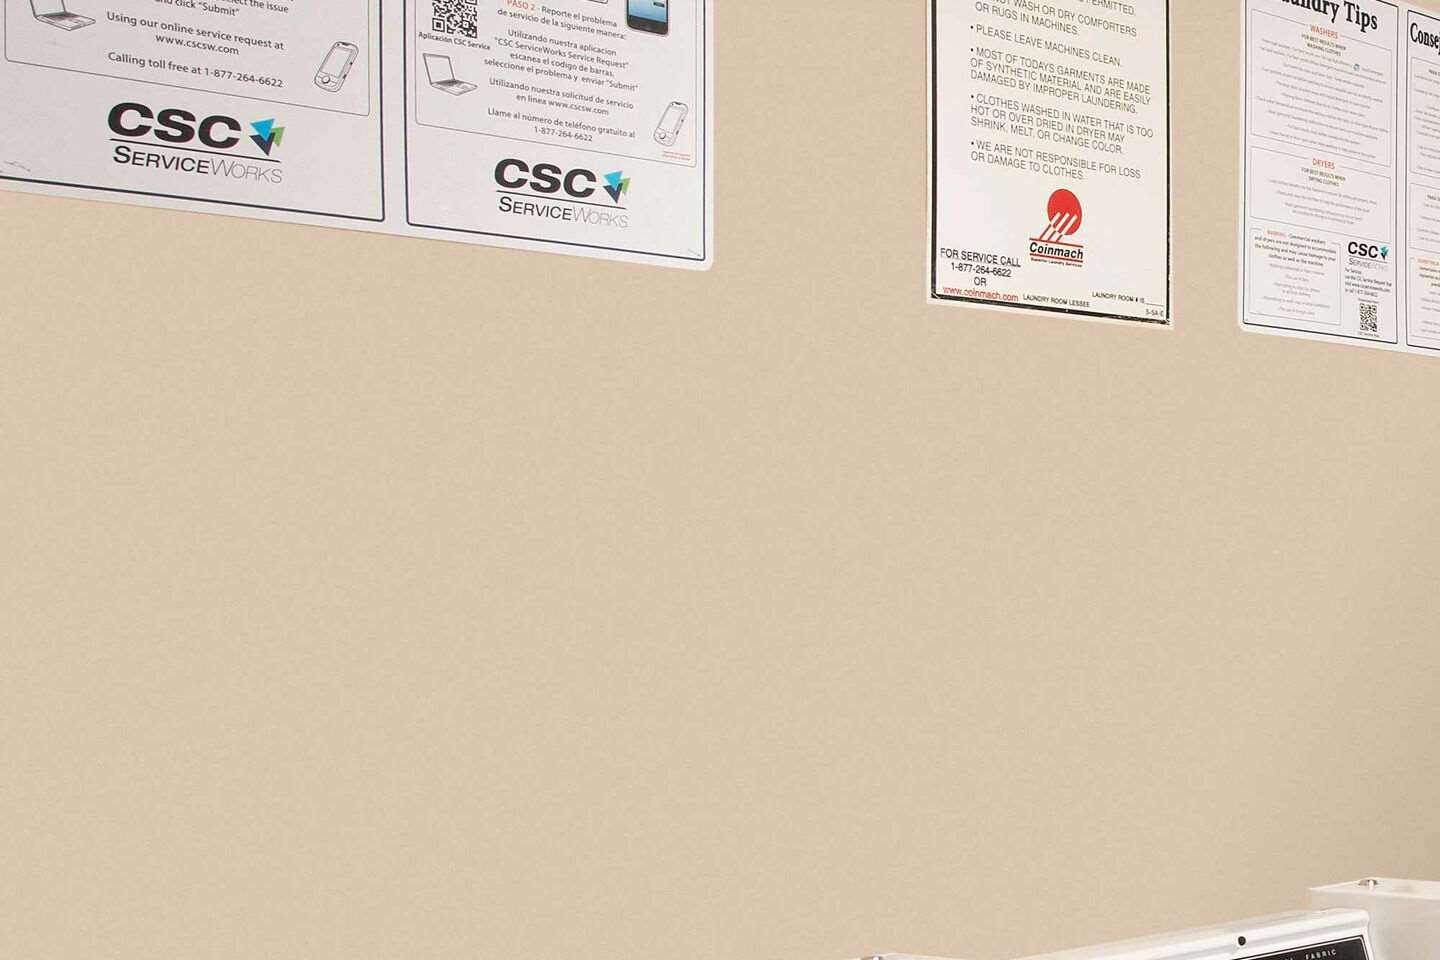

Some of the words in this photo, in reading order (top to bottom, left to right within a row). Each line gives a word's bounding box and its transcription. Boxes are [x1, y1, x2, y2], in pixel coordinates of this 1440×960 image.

[175, 0, 196, 9] click
[266, 2, 289, 13] issue
[975, 2, 989, 14] OR
[992, 6, 1017, 21] RUGS
[1021, 13, 1029, 23] IN
[498, 8, 507, 16] de
[509, 12, 539, 22] servicio
[541, 16, 550, 24] de
[552, 18, 558, 26] la
[561, 21, 595, 33] siguiente
[542, 6, 572, 18] Reporte
[582, 16, 617, 27] problema
[1042, 5, 1055, 17] OR
[1058, 9, 1075, 22] DRY
[1078, 14, 1136, 37] COMFORTERS
[1344, 1, 1378, 33] Tips
[107, 12, 137, 27] Using
[140, 19, 158, 28] our
[161, 23, 194, 35] online
[196, 29, 232, 41] service
[235, 36, 271, 48] request
[275, 42, 283, 50] at
[508, 29, 548, 43] Utilizando
[549, 39, 577, 49] nuestra
[976, 24, 1012, 41] PLEASE
[1015, 33, 1042, 48] LEAVE
[1045, 40, 1090, 59] MACHINES
[1310, 24, 1338, 39] WASHERS
[156, 36, 239, 55] www.cscsw.com
[468, 41, 490, 50] Service
[515, 42, 566, 58] ServiceWorks
[568, 52, 594, 63] Service
[510, 53, 540, 63] escanea
[108, 52, 145, 68] Calling
[148, 59, 165, 69] toll
[168, 62, 188, 73] free
[191, 67, 201, 75] at
[204, 67, 282, 87] 1-877-264-6622
[485, 59, 524, 71] seleccione
[536, 69, 574, 80] problema
[582, 77, 604, 86] enviar
[976, 47, 1003, 61] MOST
[1006, 53, 1018, 65] OF
[1057, 65, 1105, 84] GARMENTS
[1108, 76, 1124, 89] ARE
[1127, 81, 1150, 94] MADE
[970, 57, 984, 69] OF
[986, 61, 1037, 81] SYNTHETIC
[1040, 72, 1081, 90] MATERIAL
[1085, 82, 1102, 95] AND
[1104, 86, 1120, 99] ARE
[1124, 91, 1150, 105] EASILY
[971, 70, 1016, 89] DAMAGED
[1019, 80, 1030, 92] BY
[1033, 83, 1079, 102] IMPROPER
[489, 78, 529, 91] Utilizando
[532, 87, 560, 97] nuestra
[562, 92, 593, 102] solicitud
[595, 96, 604, 104] de
[606, 100, 634, 109] servicio
[548, 101, 608, 115] www.cscsw.com
[976, 93, 1019, 111] CLOTHES
[1022, 102, 1059, 119] WASHED
[1062, 110, 1070, 121] IN
[1073, 113, 1101, 128] WATER
[1104, 119, 1124, 132] THAT
[1127, 124, 1134, 134] IS
[1136, 125, 1153, 138] TOO
[108, 102, 241, 149] CSC
[488, 108, 511, 118] Llame
[598, 127, 627, 137] gratuito
[971, 104, 990, 116] HOT
[993, 108, 1006, 120] OR
[1009, 111, 1033, 125] OVER
[1036, 117, 1063, 131] DRIED
[1066, 122, 1074, 133] IN
[1077, 124, 1105, 139] DRYER
[1108, 131, 1124, 143] MAY
[535, 126, 592, 141] 1-877-264-6622
[1038, 129, 1050, 140] OR
[1053, 131, 1089, 147] CHANGE
[971, 151, 984, 162] OR
[988, 154, 1026, 170] DAMAGE
[1029, 161, 1040, 172] TO
[977, 140, 991, 151] WE
[994, 143, 1012, 155] ARE
[1015, 147, 1033, 159] NOT
[1036, 151, 1096, 171] RESPONSIBLE
[1099, 162, 1116, 175] FOR
[1119, 166, 1141, 179] LOSS
[1313, 158, 1335, 169] DRYERS
[494, 158, 597, 198] CSC
[941, 249, 958, 259] FOR
[961, 251, 997, 264] SERVICE
[1000, 256, 1021, 267] CALL
[1030, 242, 1084, 259] Coinmach
[1348, 242, 1378, 258] CSC
[974, 277, 987, 287] OR
[1023, 294, 1049, 303] LAUNDRY
[1092, 292, 1116, 300] LAUNDRY
[1305, 949, 1337, 960] FABRIC
